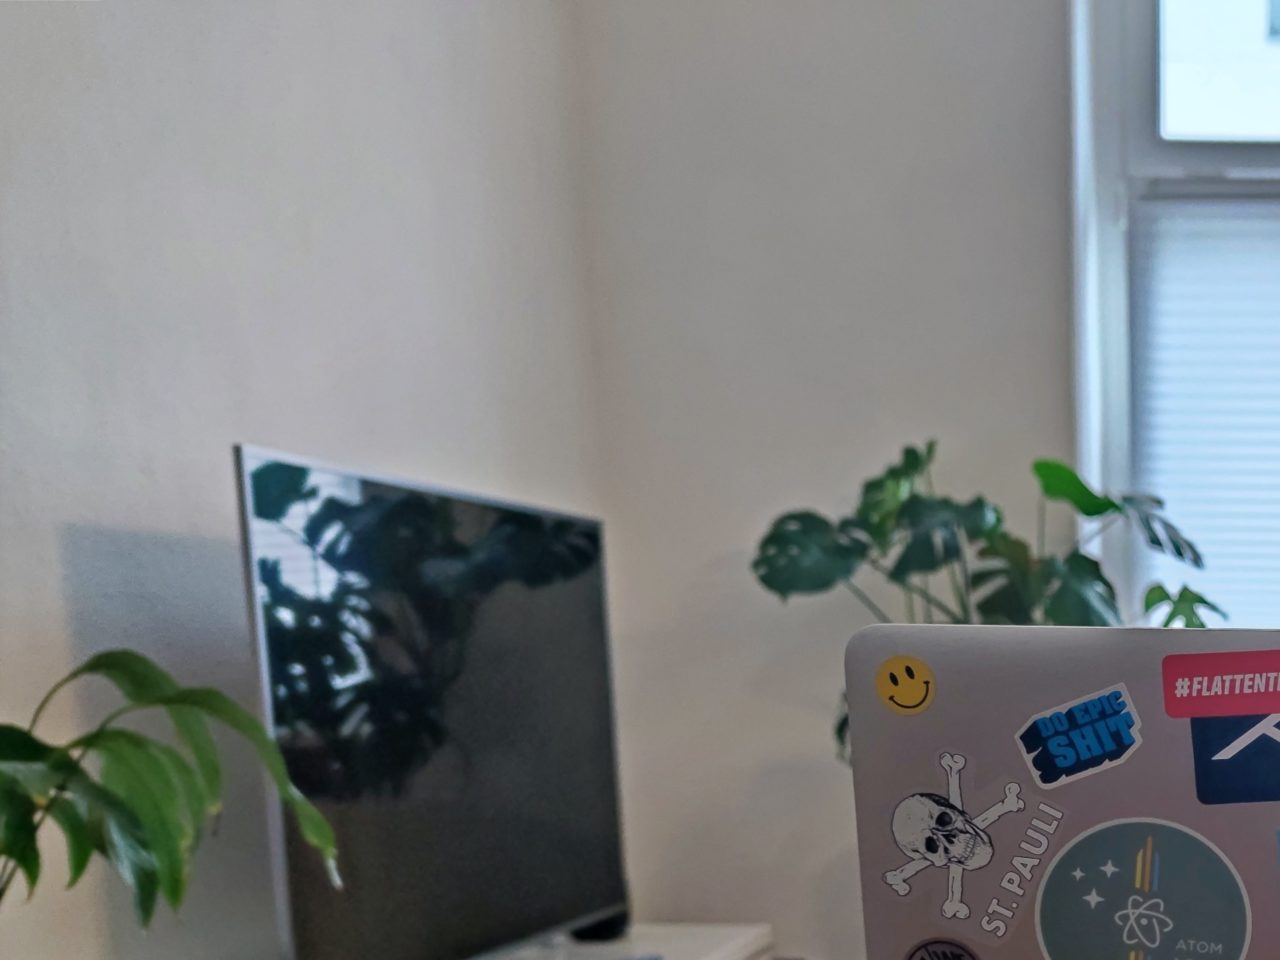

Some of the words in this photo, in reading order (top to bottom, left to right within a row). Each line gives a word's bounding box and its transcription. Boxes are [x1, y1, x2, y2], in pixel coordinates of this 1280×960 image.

[1071, 690, 1128, 725] EPIC
[1047, 711, 1137, 768] SHIT
[1175, 939, 1223, 954] ATOM
